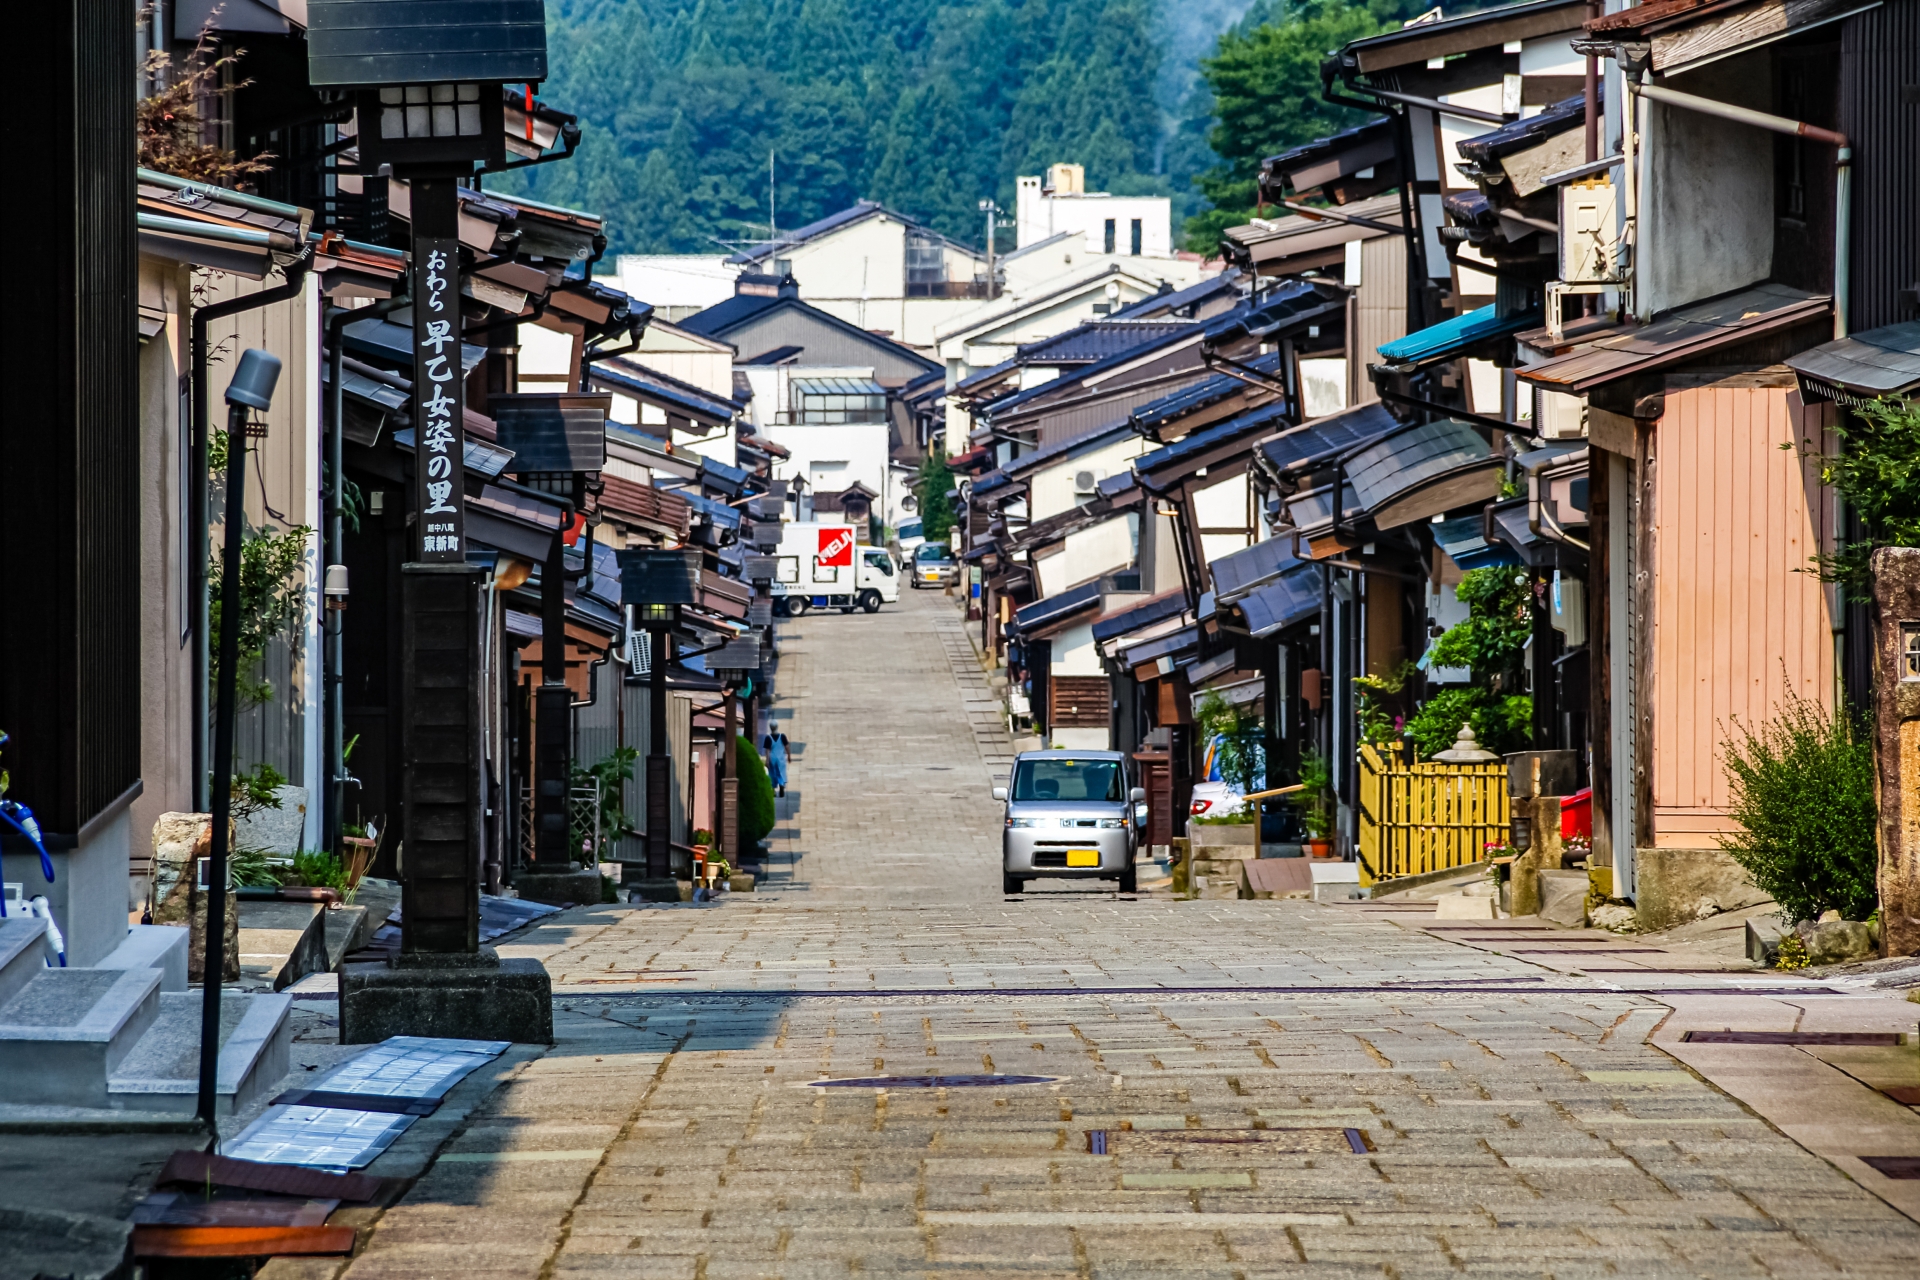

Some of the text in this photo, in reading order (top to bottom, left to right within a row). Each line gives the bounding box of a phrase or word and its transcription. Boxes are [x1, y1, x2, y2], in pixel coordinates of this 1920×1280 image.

[421, 250, 457, 514] おわら 早乙女姿の里
[424, 535, 459, 552] 東新町
[818, 530, 853, 564] MEIJI
